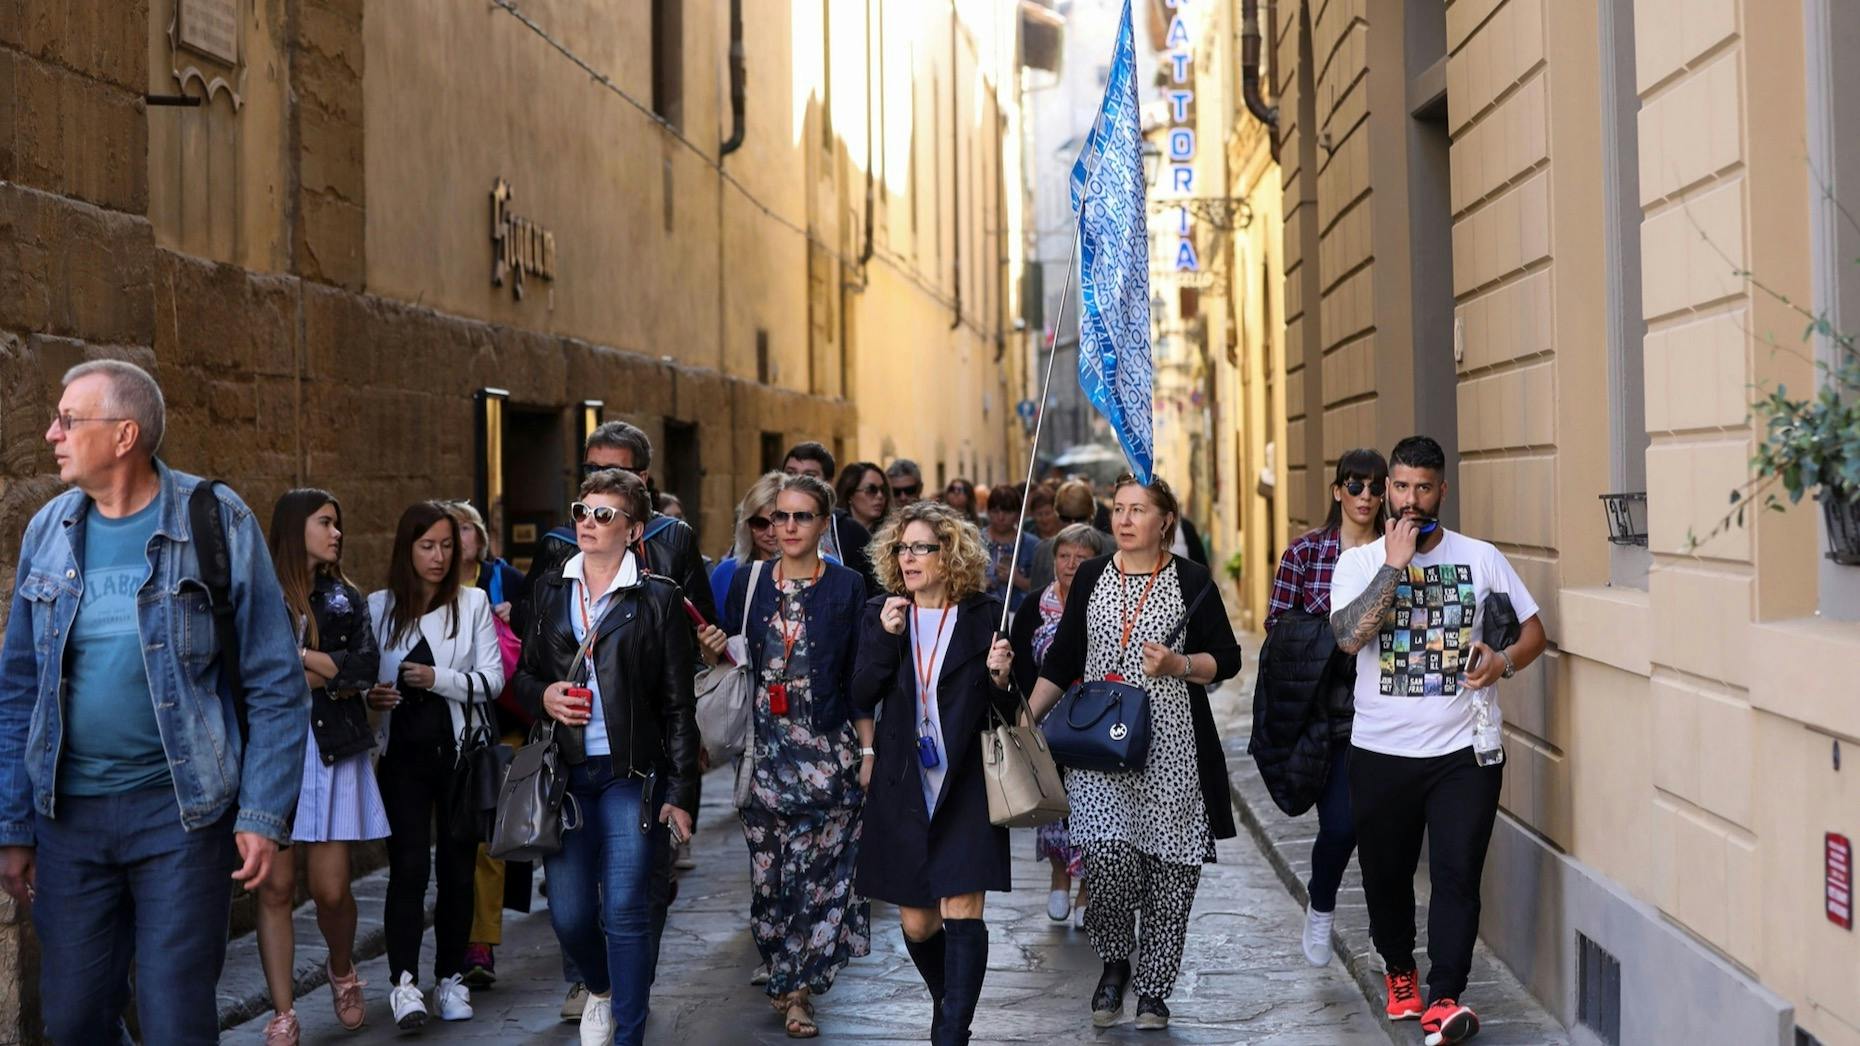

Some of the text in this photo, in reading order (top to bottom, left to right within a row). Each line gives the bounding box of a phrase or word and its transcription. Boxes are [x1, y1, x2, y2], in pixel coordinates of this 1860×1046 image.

[1165, 0, 1198, 271] ATTORIA
[1444, 588, 1456, 596] EXP
[1415, 636, 1423, 645] LA
[1396, 659, 1406, 667] RIO
[1410, 677, 1423, 686] SAN
[1408, 684, 1423, 693] FRAN
